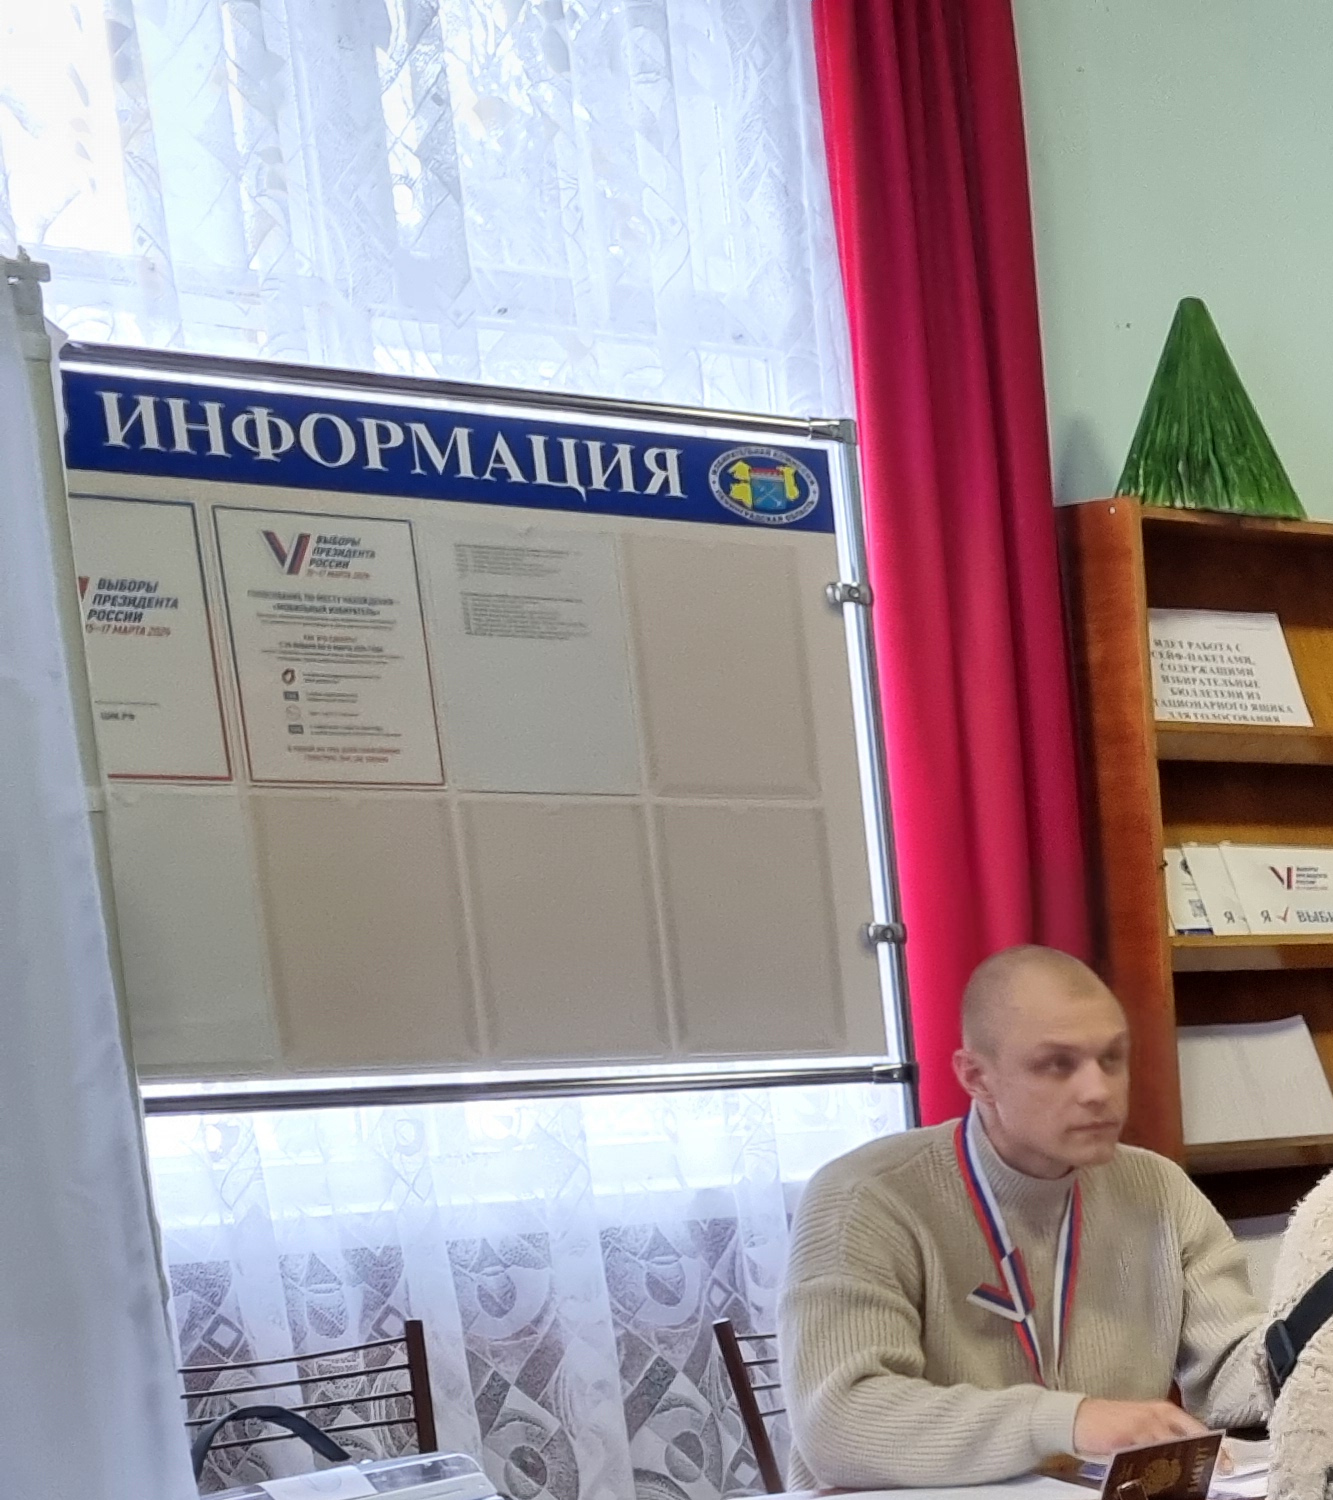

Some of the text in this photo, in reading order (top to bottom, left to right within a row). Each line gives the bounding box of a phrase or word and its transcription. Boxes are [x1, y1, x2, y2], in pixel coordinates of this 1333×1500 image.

[96, 391, 688, 501] ИНФОРМАЦИЯ
[315, 535, 361, 546] ВЫБОРЫ
[312, 547, 376, 559] ПРЕЗИДЕНТА
[308, 557, 351, 570] РОССИИ
[98, 578, 159, 593] ВЫБОРЫ
[92, 593, 179, 610] ПРЕЗИДЕНТА
[87, 608, 144, 624] РОССИИ
[111, 624, 146, 636] МАРТА
[1186, 640, 1233, 652] РАБОТА
[1160, 663, 1254, 677] СОДЕРЖАЩИМИ
[1161, 674, 1260, 689] ИЗБИРАТЕЛЬНЫЕ
[1170, 687, 1262, 701] БЮЛЛЕТЕНИ ИЗ
[1250, 703, 1294, 714] ЯЩИКА
[1224, 911, 1236, 924] Я
[1260, 909, 1272, 923] Я
